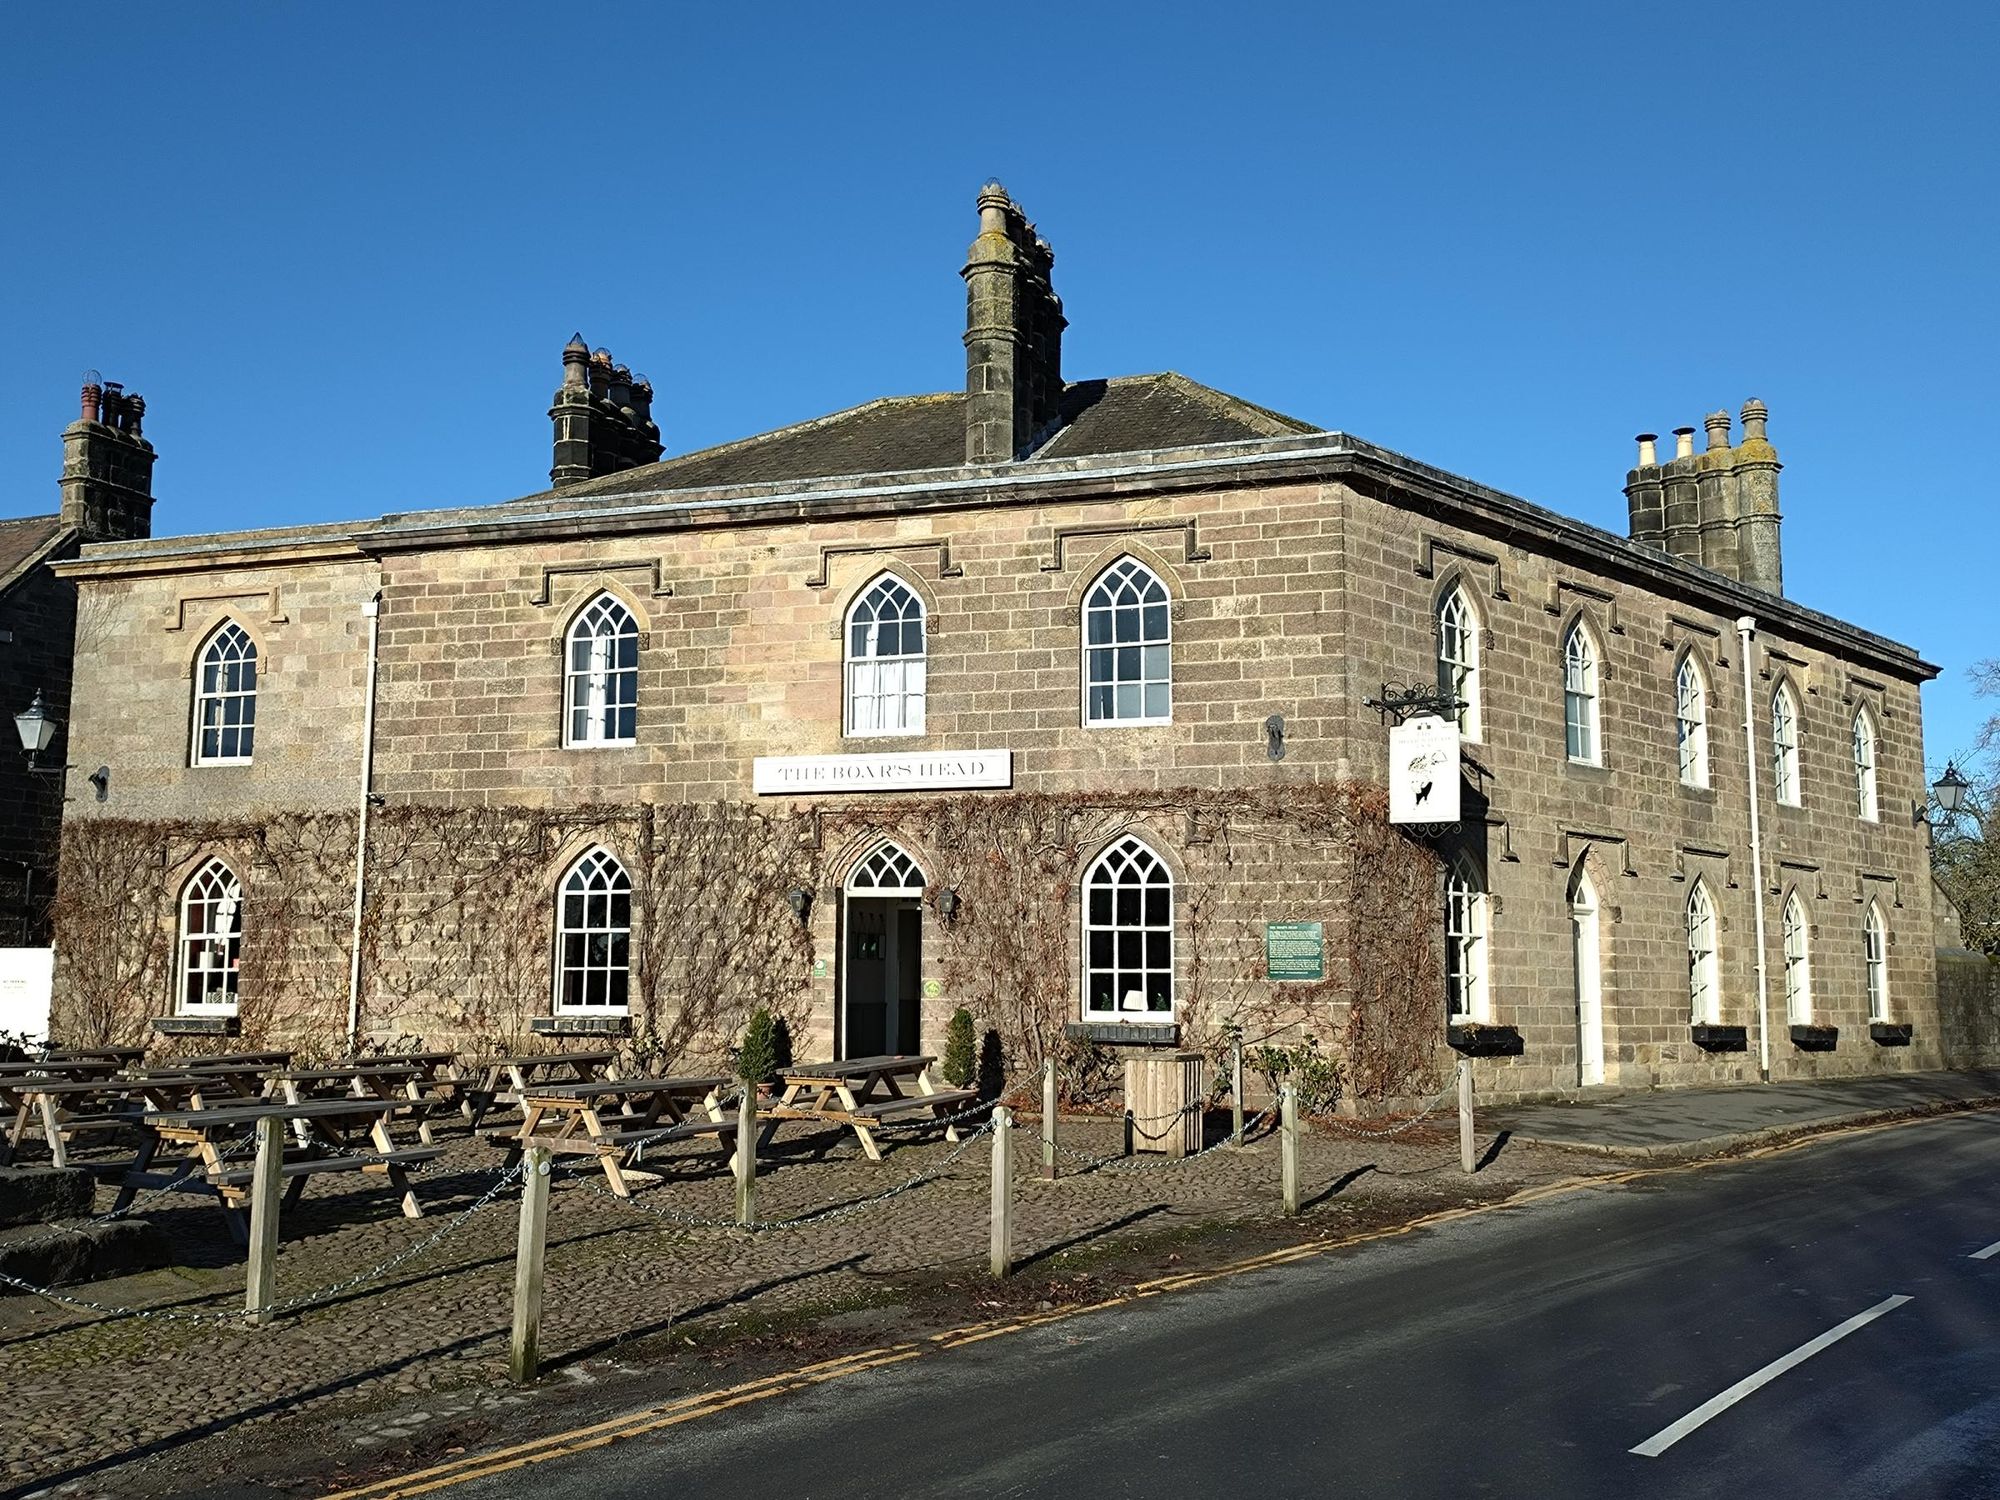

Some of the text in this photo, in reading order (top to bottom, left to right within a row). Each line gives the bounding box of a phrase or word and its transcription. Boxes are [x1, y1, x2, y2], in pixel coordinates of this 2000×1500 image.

[778, 761, 985, 781] THE BOAR'S HEAD
